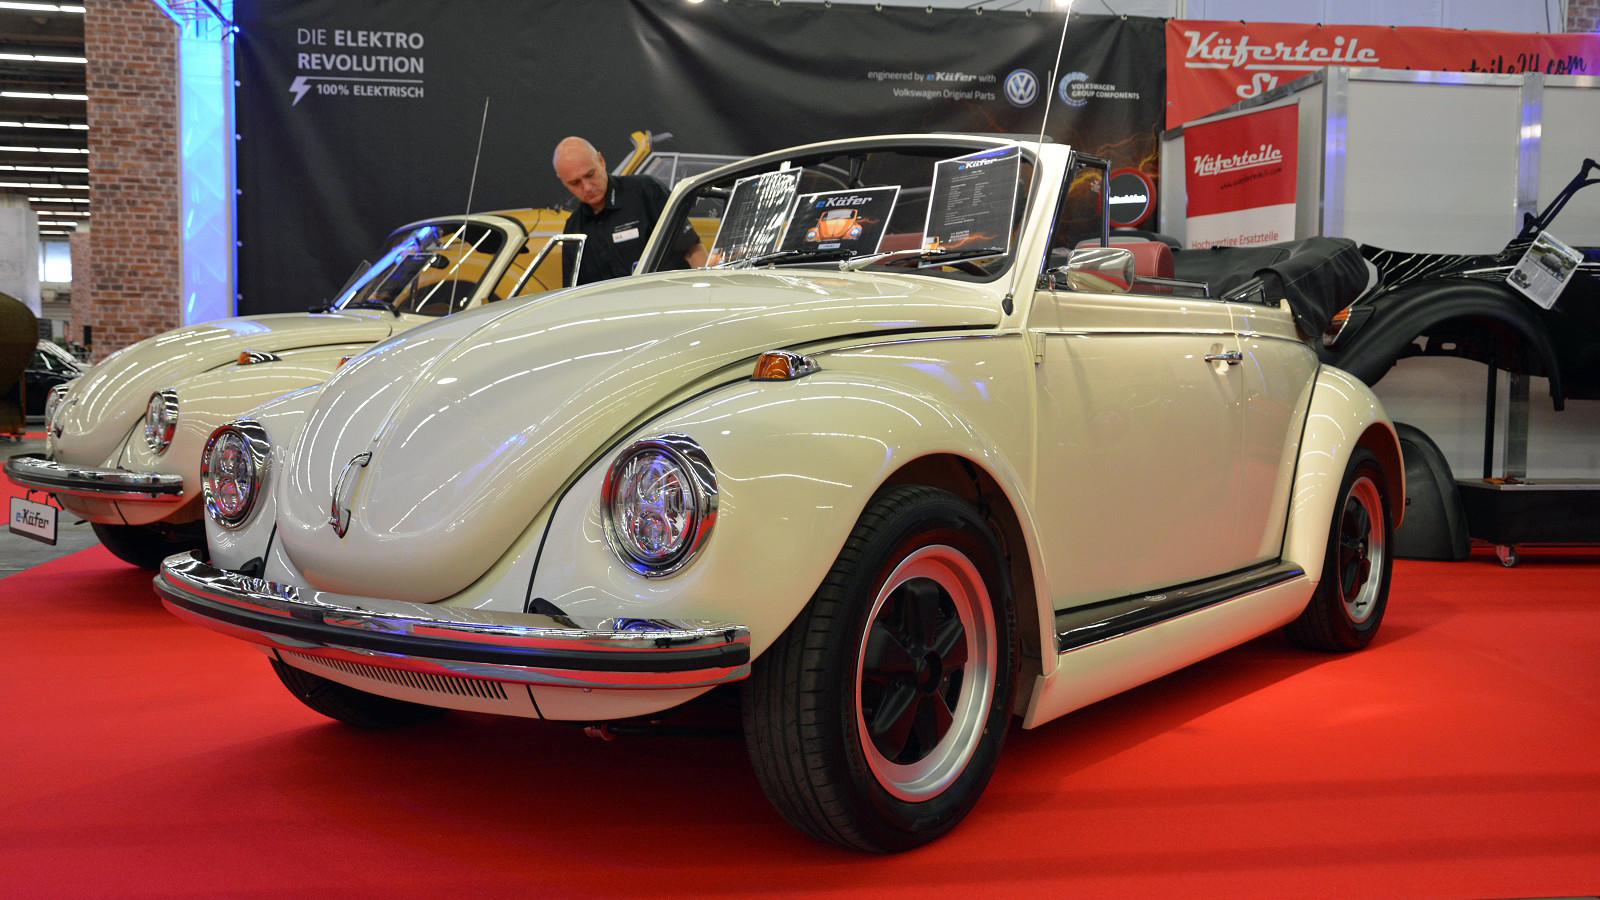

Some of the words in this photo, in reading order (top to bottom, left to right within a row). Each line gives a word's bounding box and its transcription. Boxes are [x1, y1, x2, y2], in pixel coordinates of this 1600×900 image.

[297, 28, 327, 45] DIE
[334, 30, 424, 49] ELEKTRO
[1184, 30, 1379, 67] Käferteile
[298, 53, 424, 73] REVOLUTION
[868, 71, 913, 81] engineered
[914, 72, 924, 82] by
[978, 74, 996, 82] with
[316, 84, 349, 96] 100%
[353, 85, 424, 98] ELEKTRISCH
[893, 88, 942, 99] Volkswagen
[943, 89, 973, 100] Original
[974, 91, 996, 100] Parts
[1071, 83, 1116, 91] VOLKSWAGEN
[1071, 90, 1095, 98] GROUP
[1095, 91, 1140, 100] COMPONENTS
[1194, 144, 1283, 176] Käferteile
[1239, 230, 1279, 245] Ersatzteile
[15, 508, 49, 529] e-Käfer
